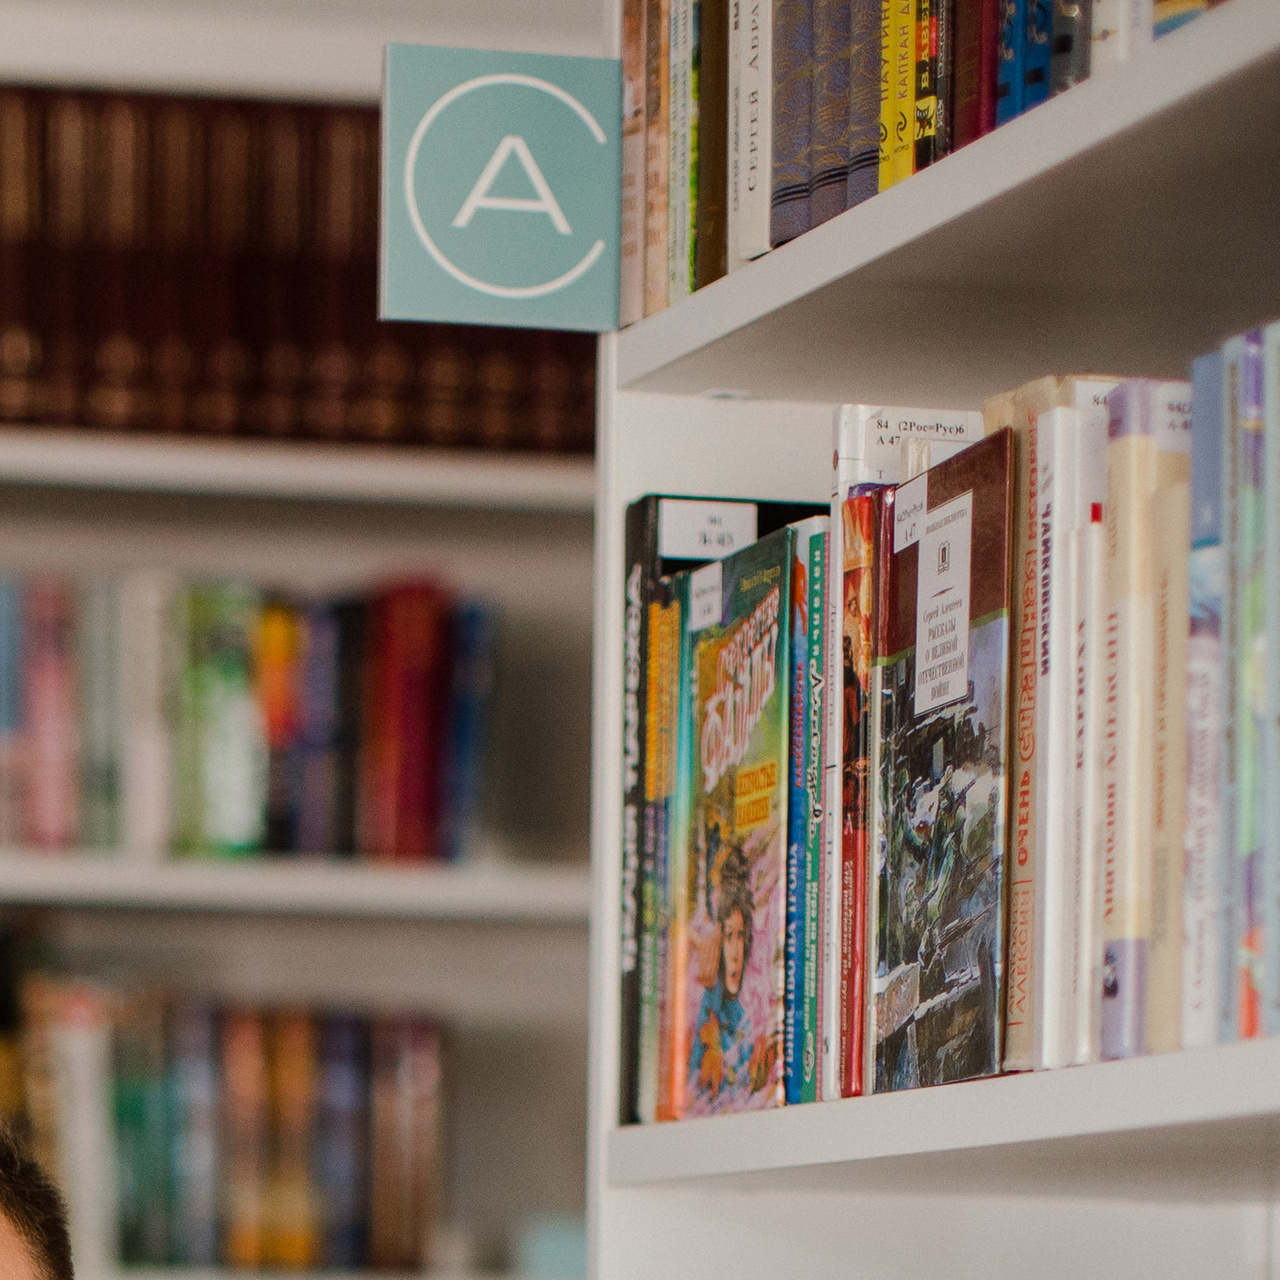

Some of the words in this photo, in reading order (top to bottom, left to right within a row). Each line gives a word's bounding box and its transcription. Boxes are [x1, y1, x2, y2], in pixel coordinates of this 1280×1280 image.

[748, 0, 760, 71] АБРА
[896, 25, 910, 99] КАПКАН
[451, 134, 572, 234] А
[876, 420, 889, 430] 84
[1017, 770, 1031, 867] ОЧЕНЬ
